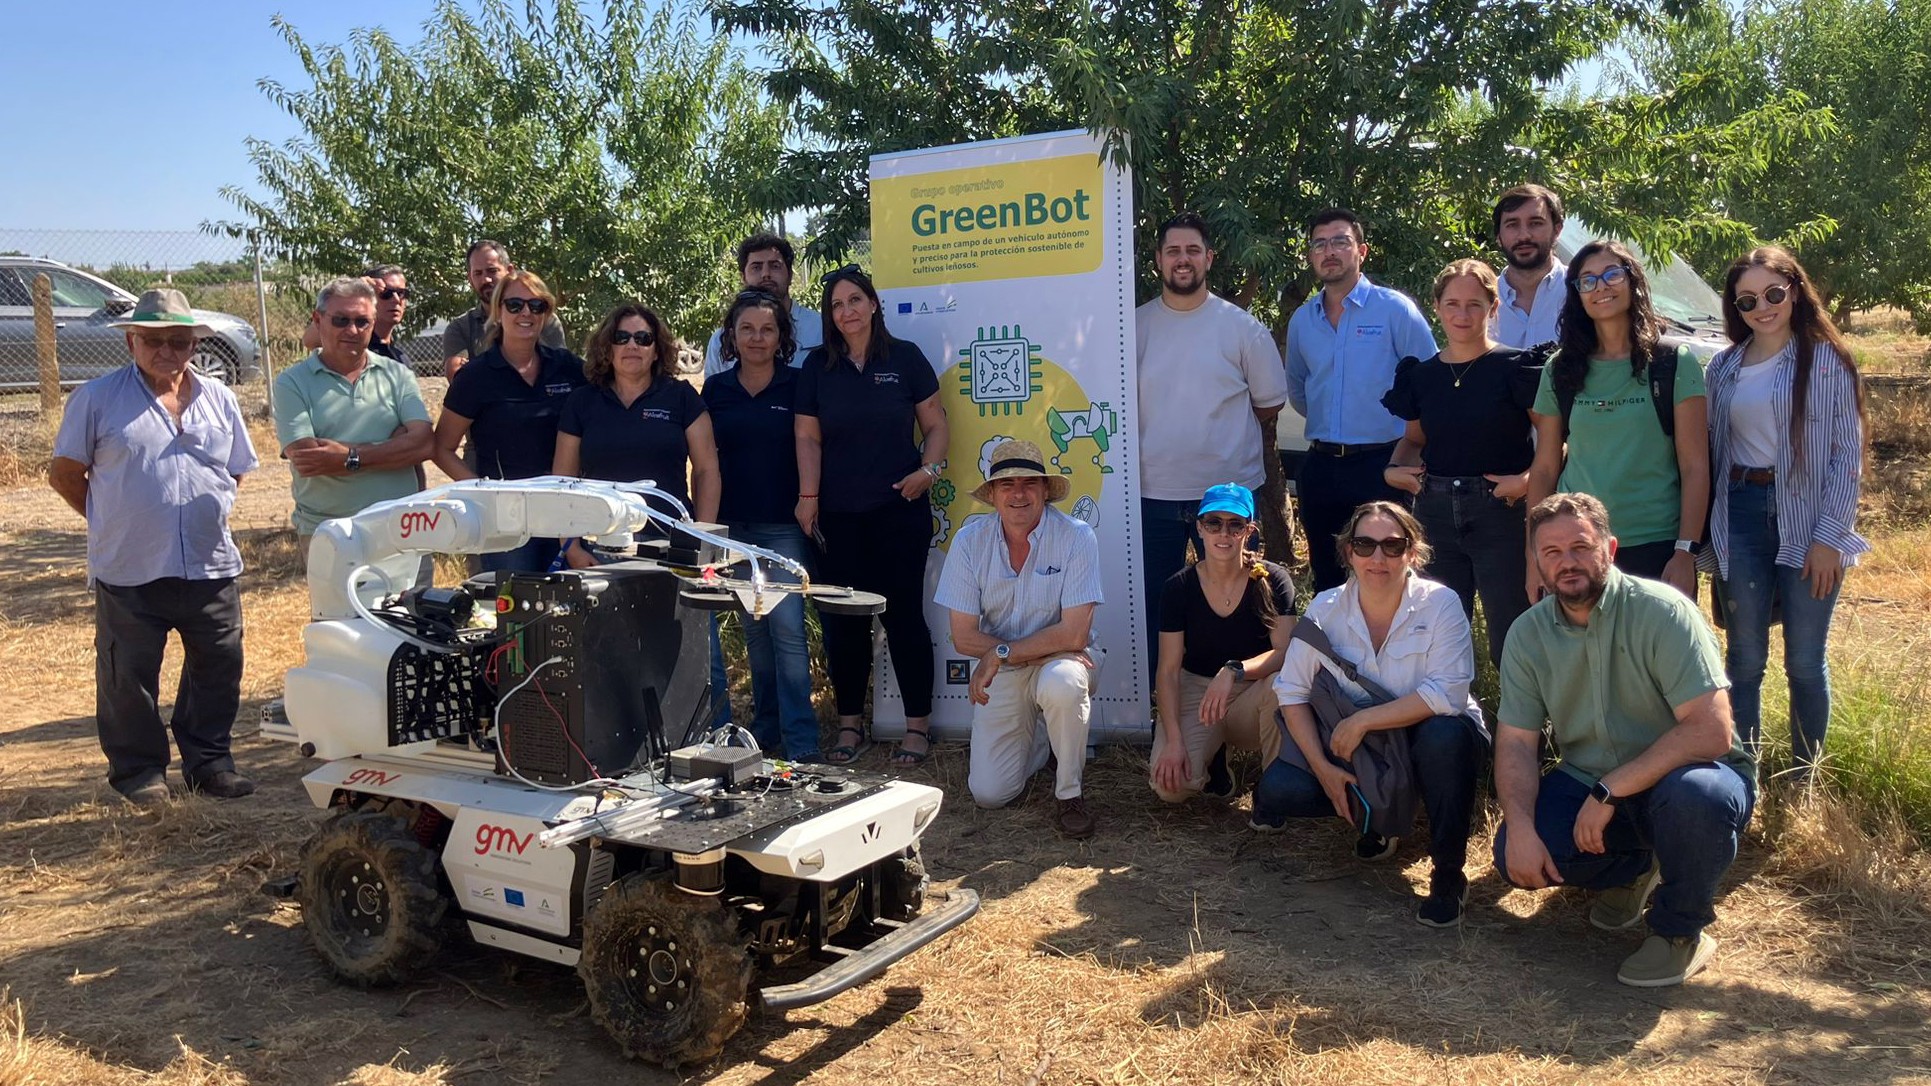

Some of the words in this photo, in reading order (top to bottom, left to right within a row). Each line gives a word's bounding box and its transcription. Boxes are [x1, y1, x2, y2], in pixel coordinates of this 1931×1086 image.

[911, 187, 945, 199] Grupo
[949, 179, 1005, 195] operativo
[911, 189, 1090, 236] GreenBot
[912, 243, 940, 252] Puesta
[954, 239, 981, 248] campo
[983, 237, 993, 245] de
[1047, 229, 1090, 240] autónomo
[912, 257, 918, 265] y
[919, 253, 949, 264] preciso
[950, 251, 968, 261] para
[980, 246, 1026, 258] protección
[1027, 242, 1073, 253] sostenible
[1074, 241, 1085, 249] de
[912, 264, 944, 274] cultivos
[1607, 397, 1646, 407] HILFIGER
[400, 510, 441, 539] gmv
[341, 768, 402, 786] gmv
[474, 823, 534, 856] gmv
